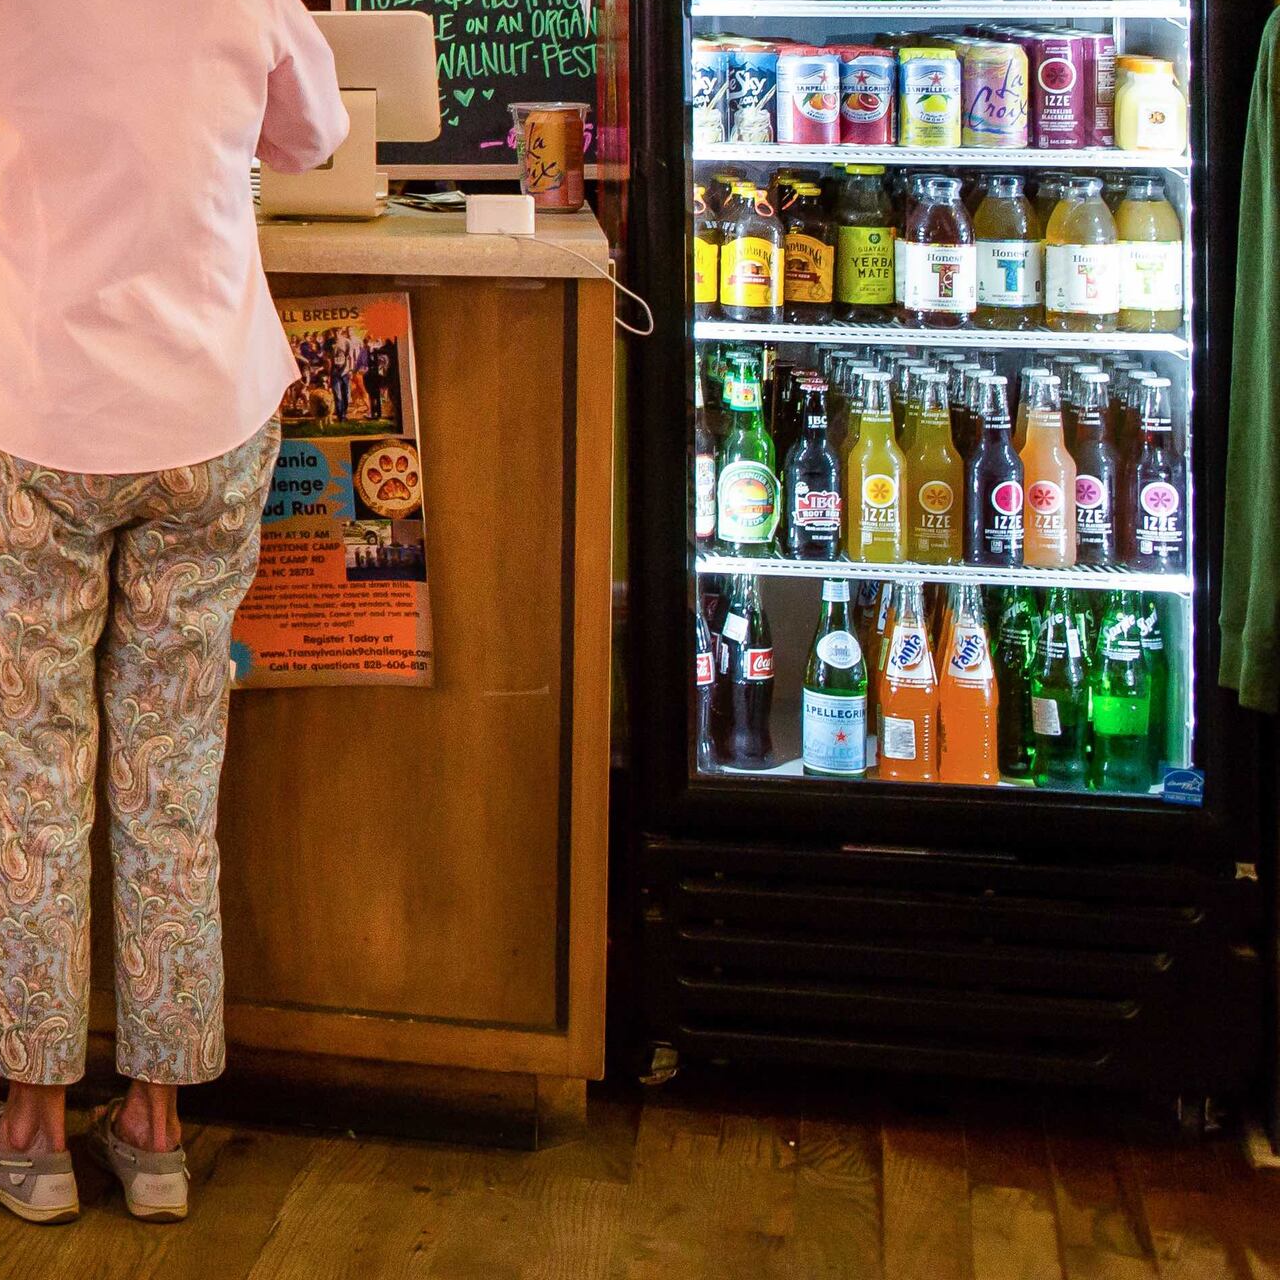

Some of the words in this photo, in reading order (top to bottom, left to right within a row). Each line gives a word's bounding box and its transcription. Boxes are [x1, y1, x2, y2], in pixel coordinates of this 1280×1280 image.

[465, 16, 489, 35] ON
[495, 12, 524, 35] AN
[1045, 95, 1071, 107] IZZE
[927, 253, 963, 264] Honest
[991, 248, 1030, 259] Honest
[851, 257, 894, 268] YERBA
[857, 269, 890, 279] MATE
[302, 306, 360, 323] BREEDS
[292, 500, 328, 516] Run
[863, 508, 895, 523] IZZE
[921, 514, 952, 529] IZZE
[994, 515, 1023, 530] IZZE
[1143, 515, 1178, 532] IZZE
[890, 633, 922, 671] Fanta
[951, 633, 983, 671] Fanta
